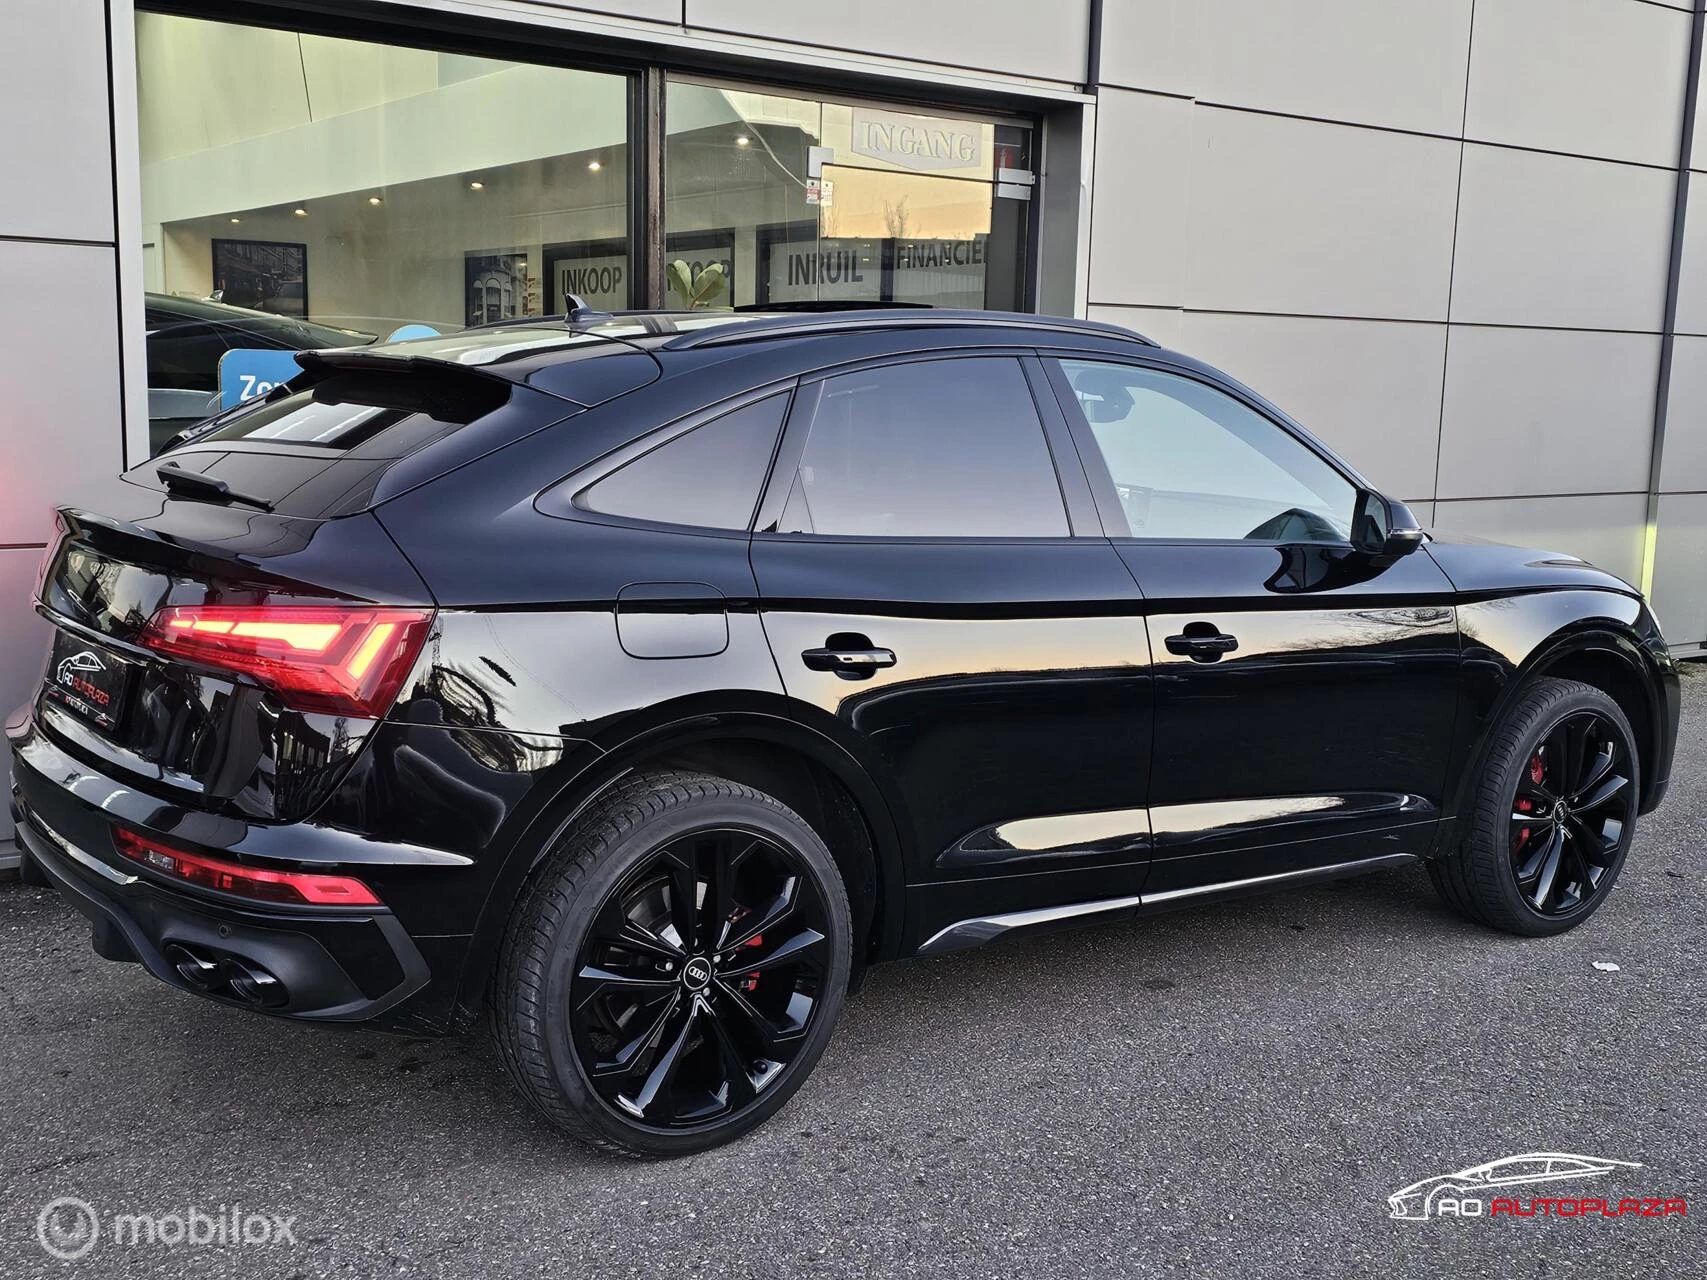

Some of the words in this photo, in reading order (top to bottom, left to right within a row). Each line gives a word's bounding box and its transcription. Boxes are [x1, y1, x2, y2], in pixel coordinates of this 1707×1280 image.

[860, 121, 976, 162] INGANG
[788, 249, 863, 286] INRUIL
[896, 239, 987, 269] FINANCIE
[562, 267, 622, 295] INKOOP
